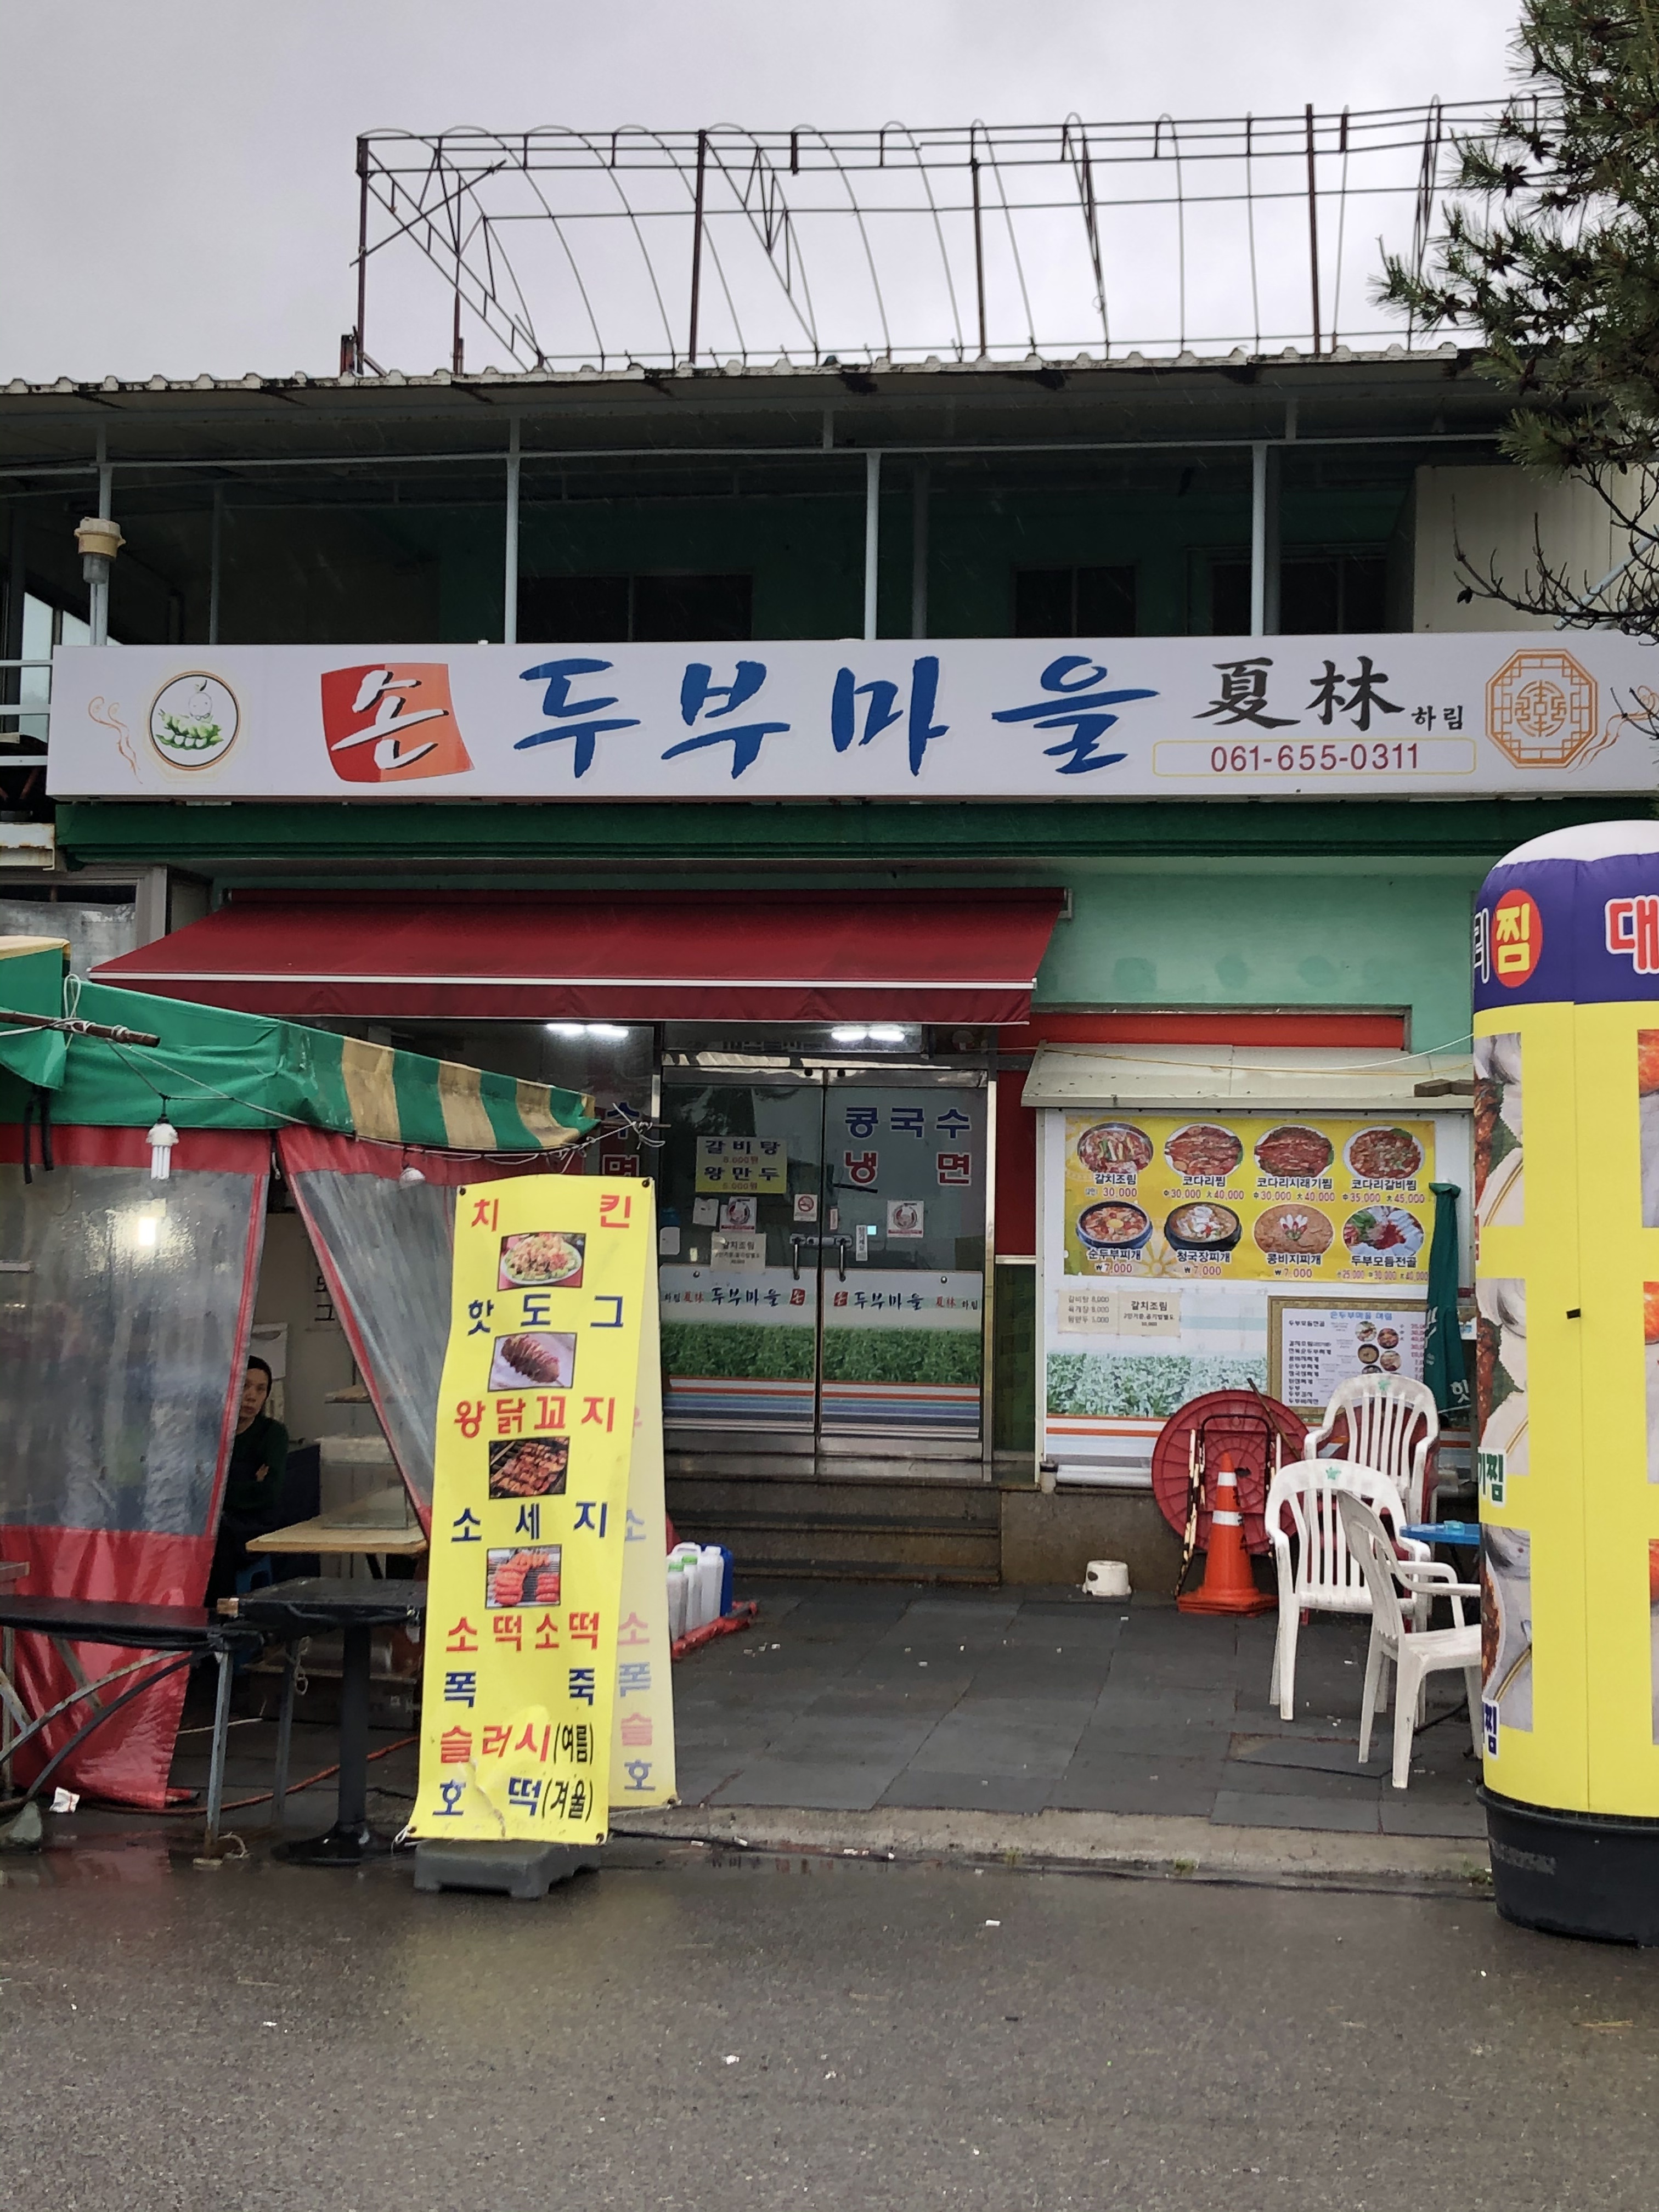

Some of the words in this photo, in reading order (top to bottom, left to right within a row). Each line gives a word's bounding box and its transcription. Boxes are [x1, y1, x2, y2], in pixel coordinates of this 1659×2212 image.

[330, 669, 450, 769] 손
[1193, 656, 1404, 730] 夏林
[1411, 705, 1464, 730] 하림
[1211, 744, 1418, 774] 061-655-0311
[845, 1107, 970, 1139] 콩국수
[705, 1140, 781, 1155] 갈비탕
[704, 1166, 780, 1181] 왕만두
[844, 1151, 971, 1186] 냉면
[1095, 1174, 1136, 1184] 갈치조림
[1183, 1176, 1226, 1187] 코다리찜
[1257, 1177, 1333, 1189] 코다리시래기찜
[1352, 1180, 1417, 1191] 코다리갈비찜
[1103, 1187, 1137, 1198] 30,000
[1087, 1249, 1141, 1260] 순두부찌개
[1177, 1250, 1230, 1262] 청국장찌개
[1267, 1254, 1321, 1265] 콩비지찌개
[454, 1395, 616, 1438] 왕닭꼬지
[451, 1502, 608, 1543] 소세지
[445, 1612, 600, 1654] 소떡소떡
